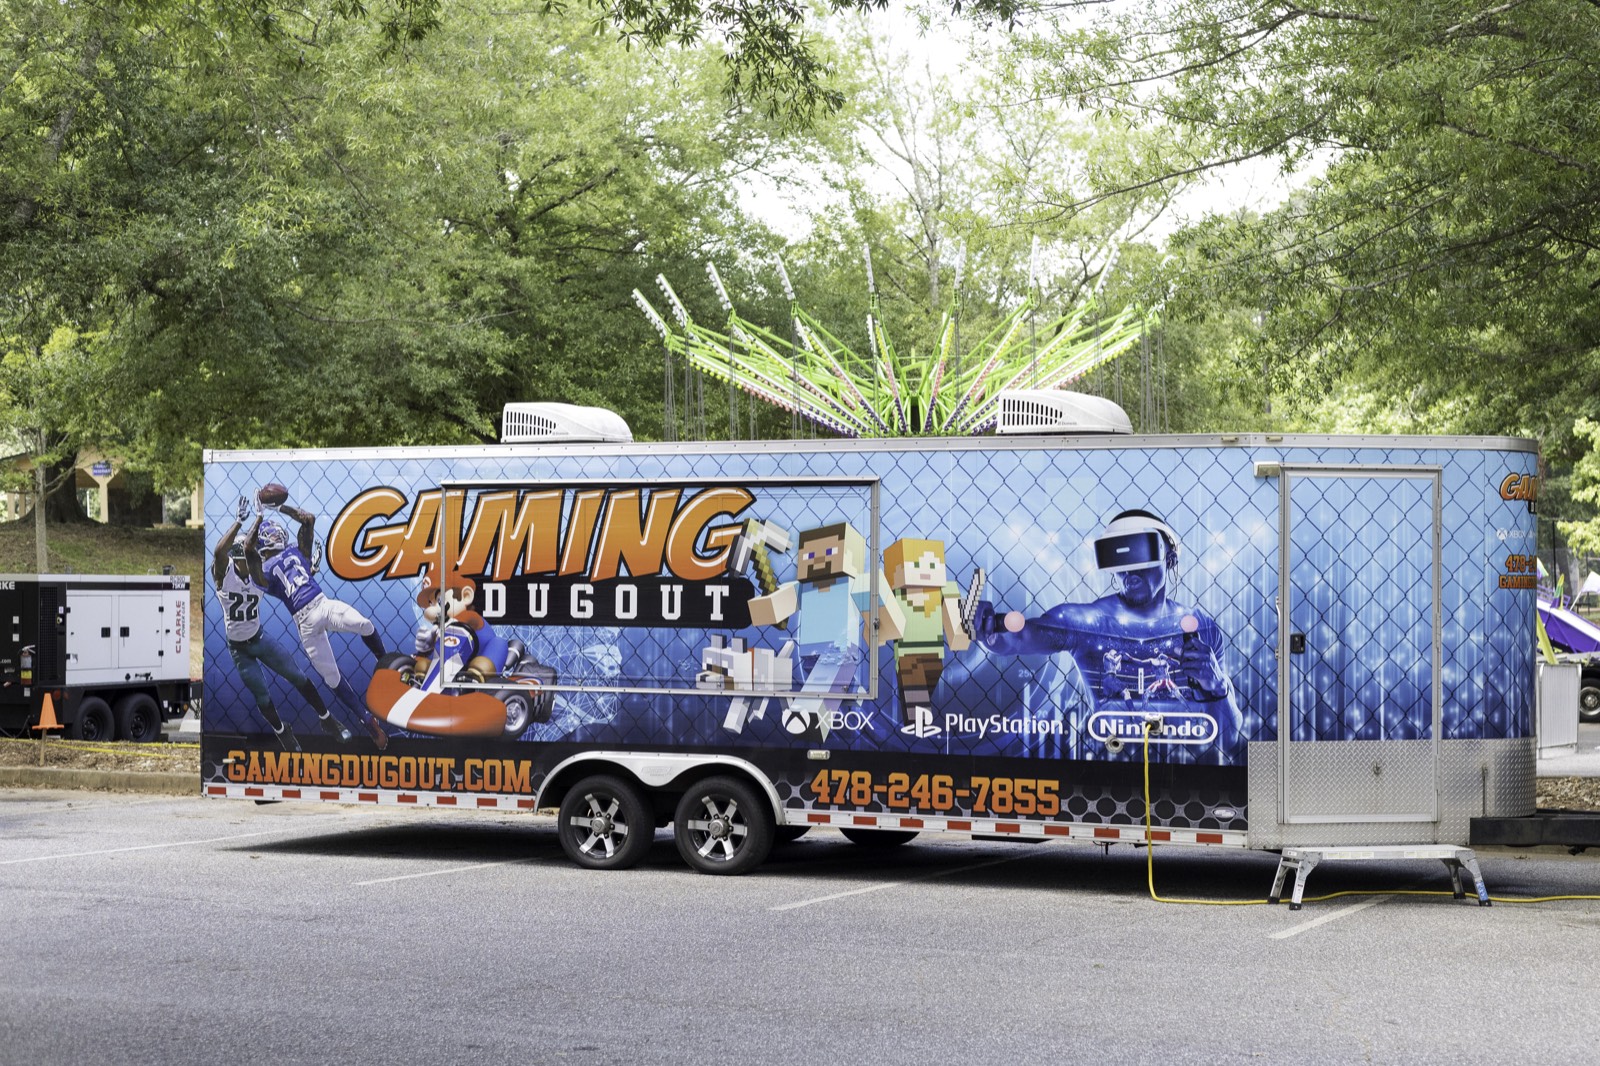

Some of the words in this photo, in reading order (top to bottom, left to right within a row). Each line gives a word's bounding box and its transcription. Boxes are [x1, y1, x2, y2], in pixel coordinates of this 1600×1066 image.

[327, 486, 757, 582] GAMING
[272, 555, 310, 598] 13
[229, 592, 260, 622] 22
[482, 583, 730, 621] DUGOUT
[815, 711, 875, 731] XBOX
[945, 713, 1064, 740] PlayStation
[1099, 718, 1206, 737] Nintndo
[227, 750, 532, 794] GAMINGDUGOUT.COM
[810, 769, 1060, 817] 478-246-7855
